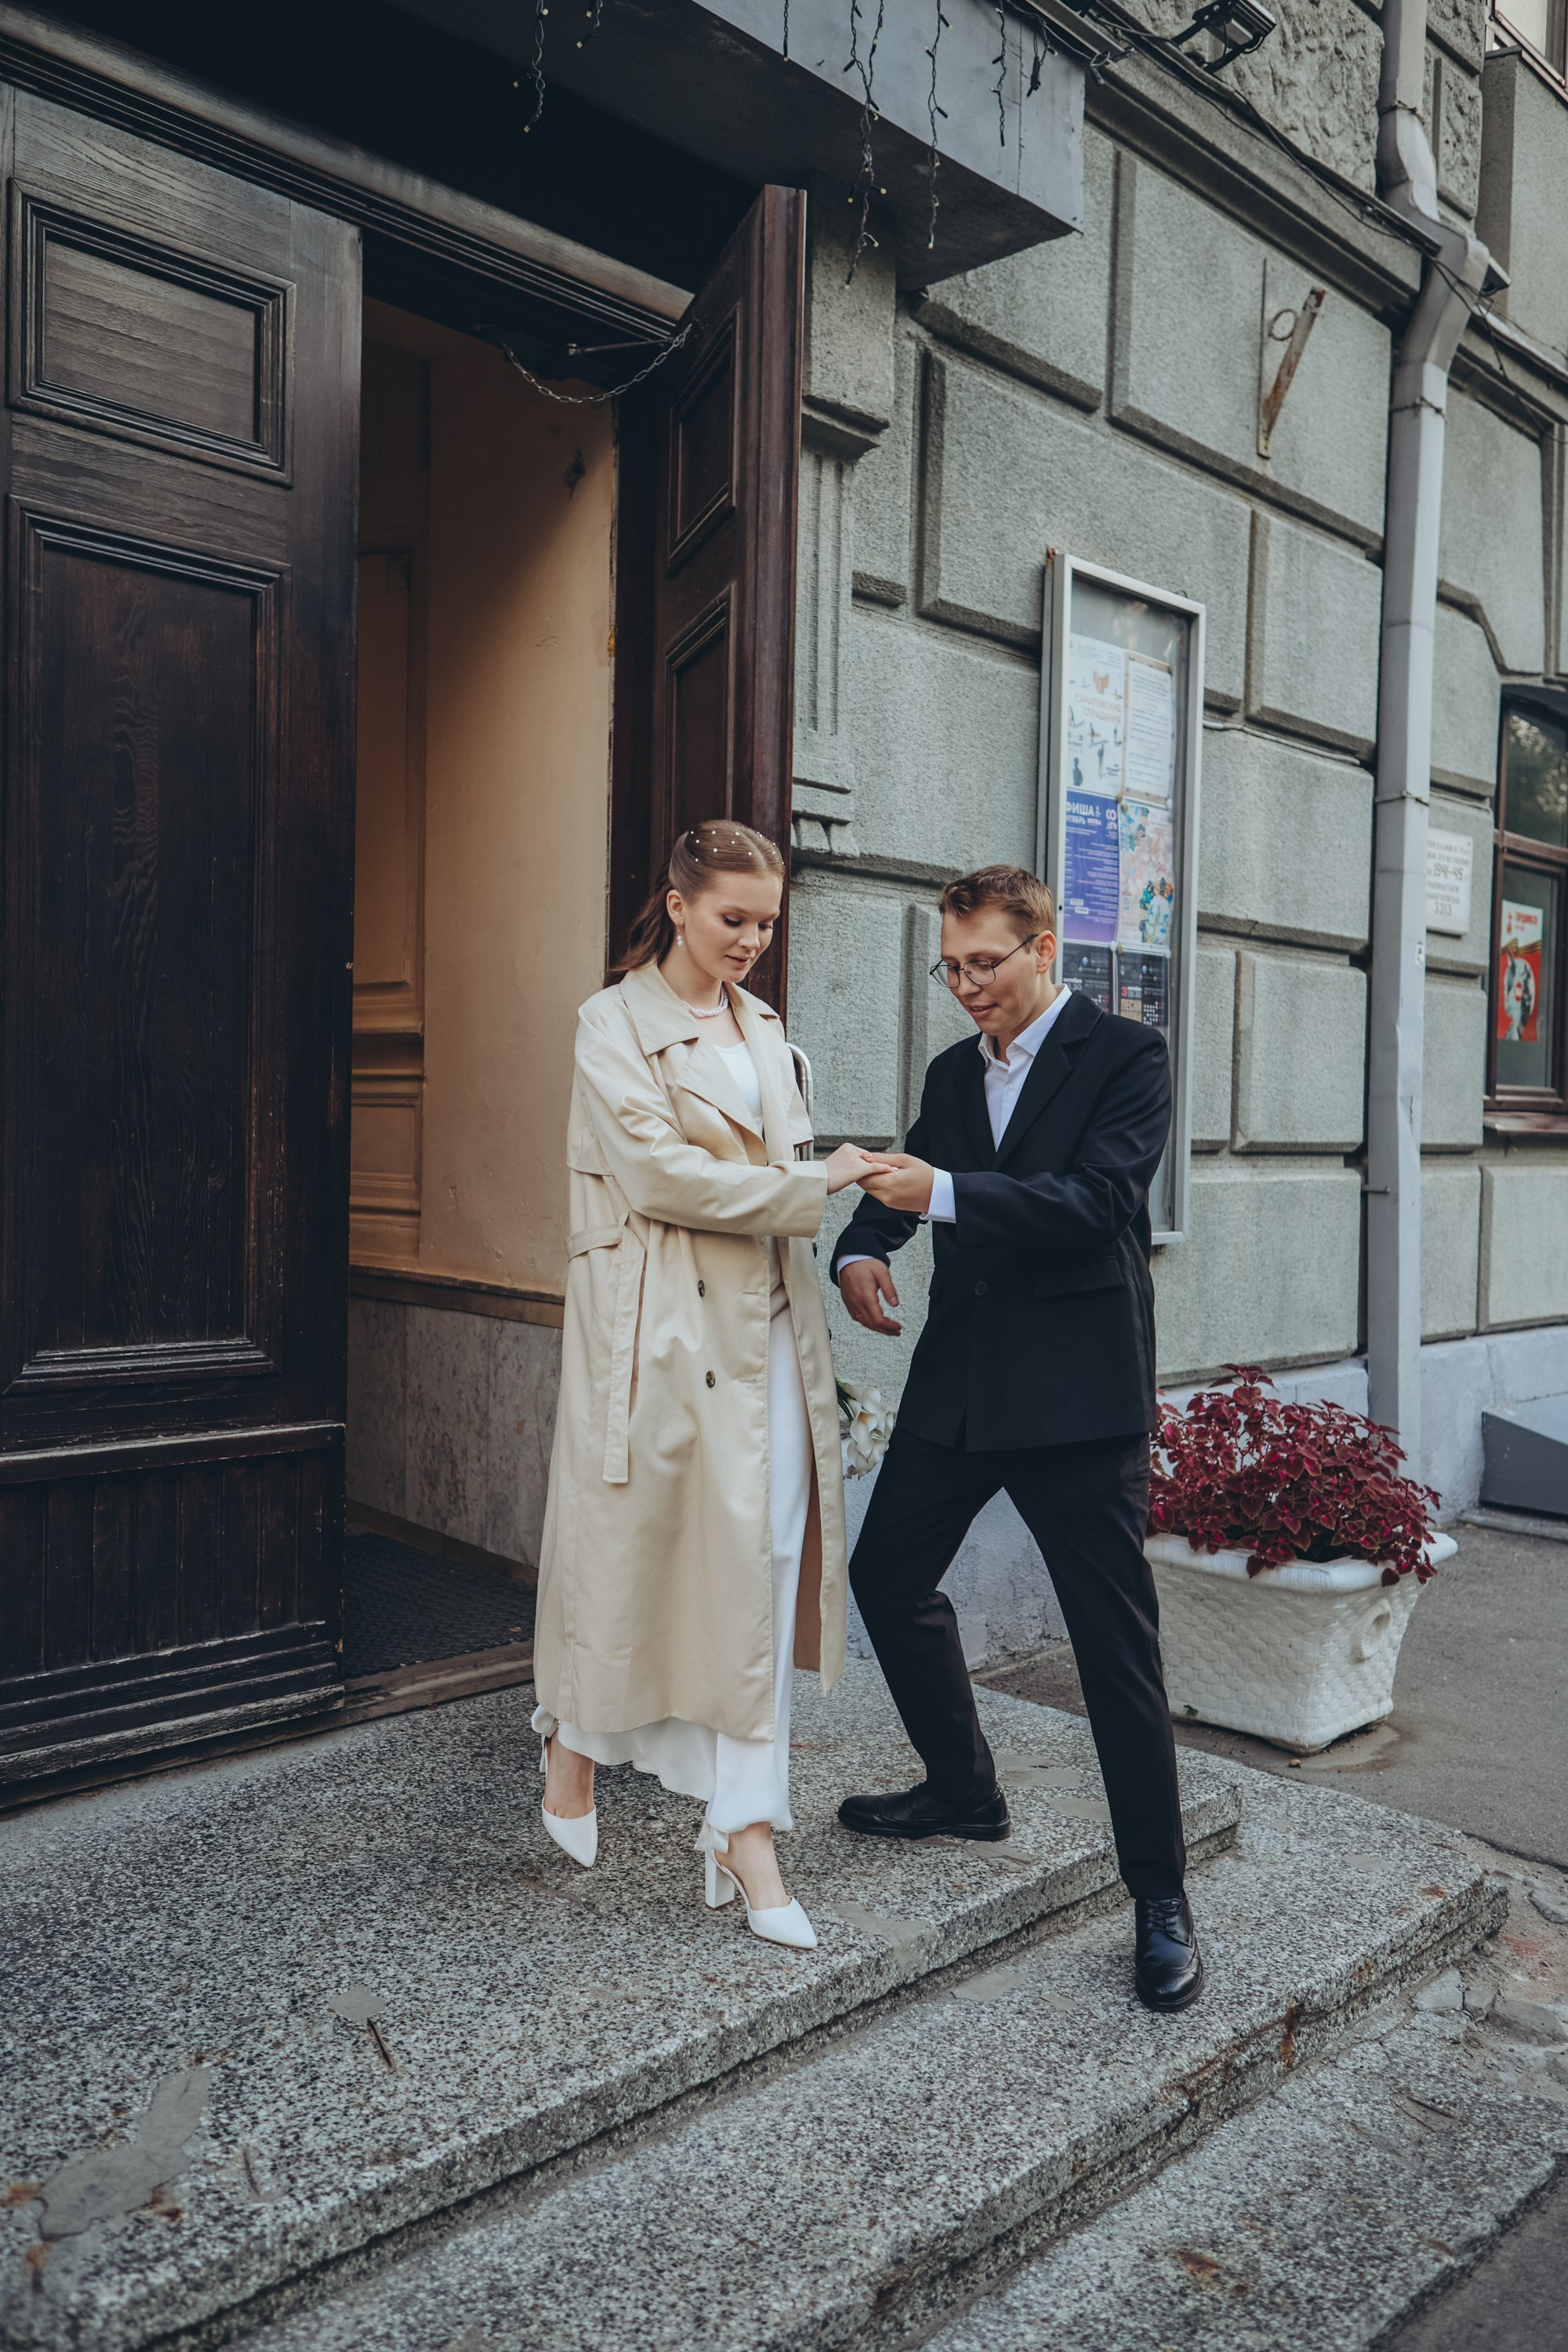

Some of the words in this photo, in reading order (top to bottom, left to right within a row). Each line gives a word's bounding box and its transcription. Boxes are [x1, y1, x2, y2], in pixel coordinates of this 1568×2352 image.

[1066, 801, 1094, 816] ФИША
[1121, 986, 1127, 996] 3
[1121, 998, 1142, 1011] ПЕСНИ
